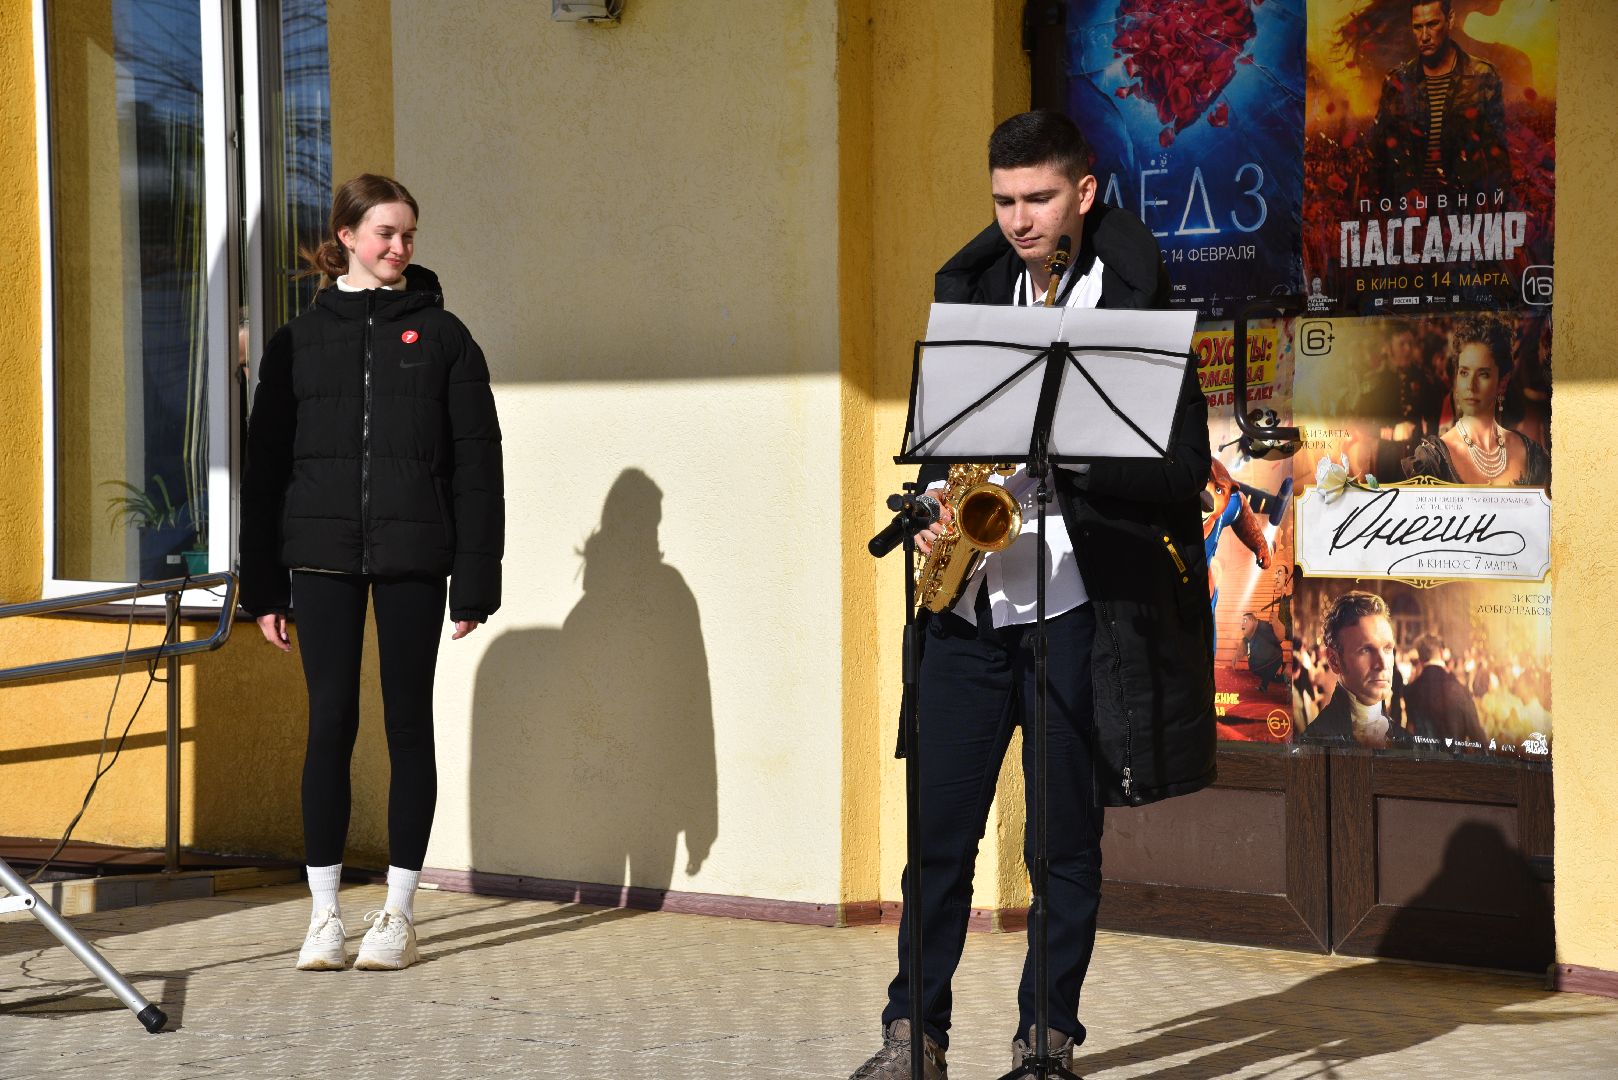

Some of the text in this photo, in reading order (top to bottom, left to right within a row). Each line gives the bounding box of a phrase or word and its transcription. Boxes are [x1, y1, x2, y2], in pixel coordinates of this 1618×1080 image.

[1231, 162, 1268, 233] 3
[1360, 188, 1504, 213] ПОЗЫВНОЙ
[1340, 211, 1527, 268] ПАССАЖИР
[1171, 249, 1184, 263] 14
[1187, 245, 1256, 263] ФЕВРАЛЯ
[1356, 271, 1510, 291] В КИНО С 14 МАРТА
[1307, 328, 1335, 350] 6+
[1328, 488, 1526, 575] Онегин
[1418, 556, 1518, 571] В КИНО С 7 МАРТА
[1269, 716, 1289, 730] 6+
